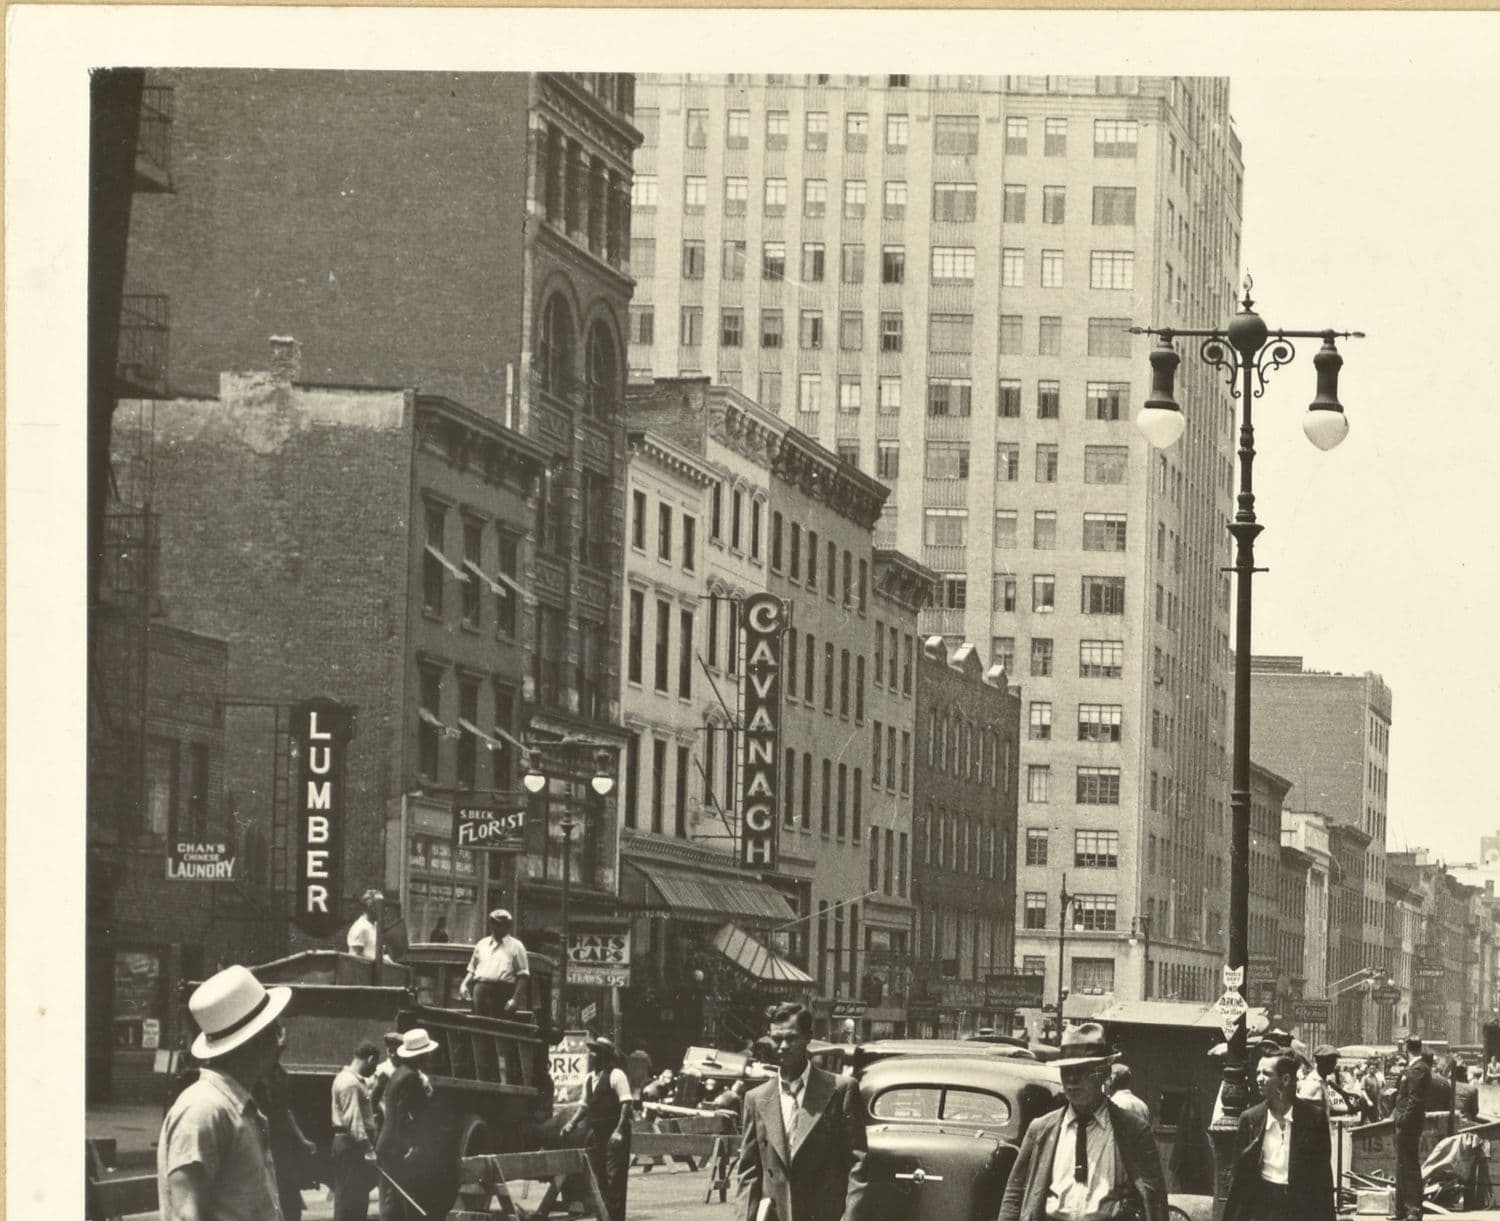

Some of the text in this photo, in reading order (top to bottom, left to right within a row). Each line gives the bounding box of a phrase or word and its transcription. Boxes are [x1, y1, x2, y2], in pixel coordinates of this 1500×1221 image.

[746, 601, 779, 863] CAVANAGH
[306, 711, 331, 912] LUMBER
[458, 811, 526, 845] FLORIST
[177, 843, 226, 854] CHAN'S
[167, 856, 236, 878] LAUNDRY
[568, 935, 625, 950] HATS
[572, 948, 624, 962] CAPS
